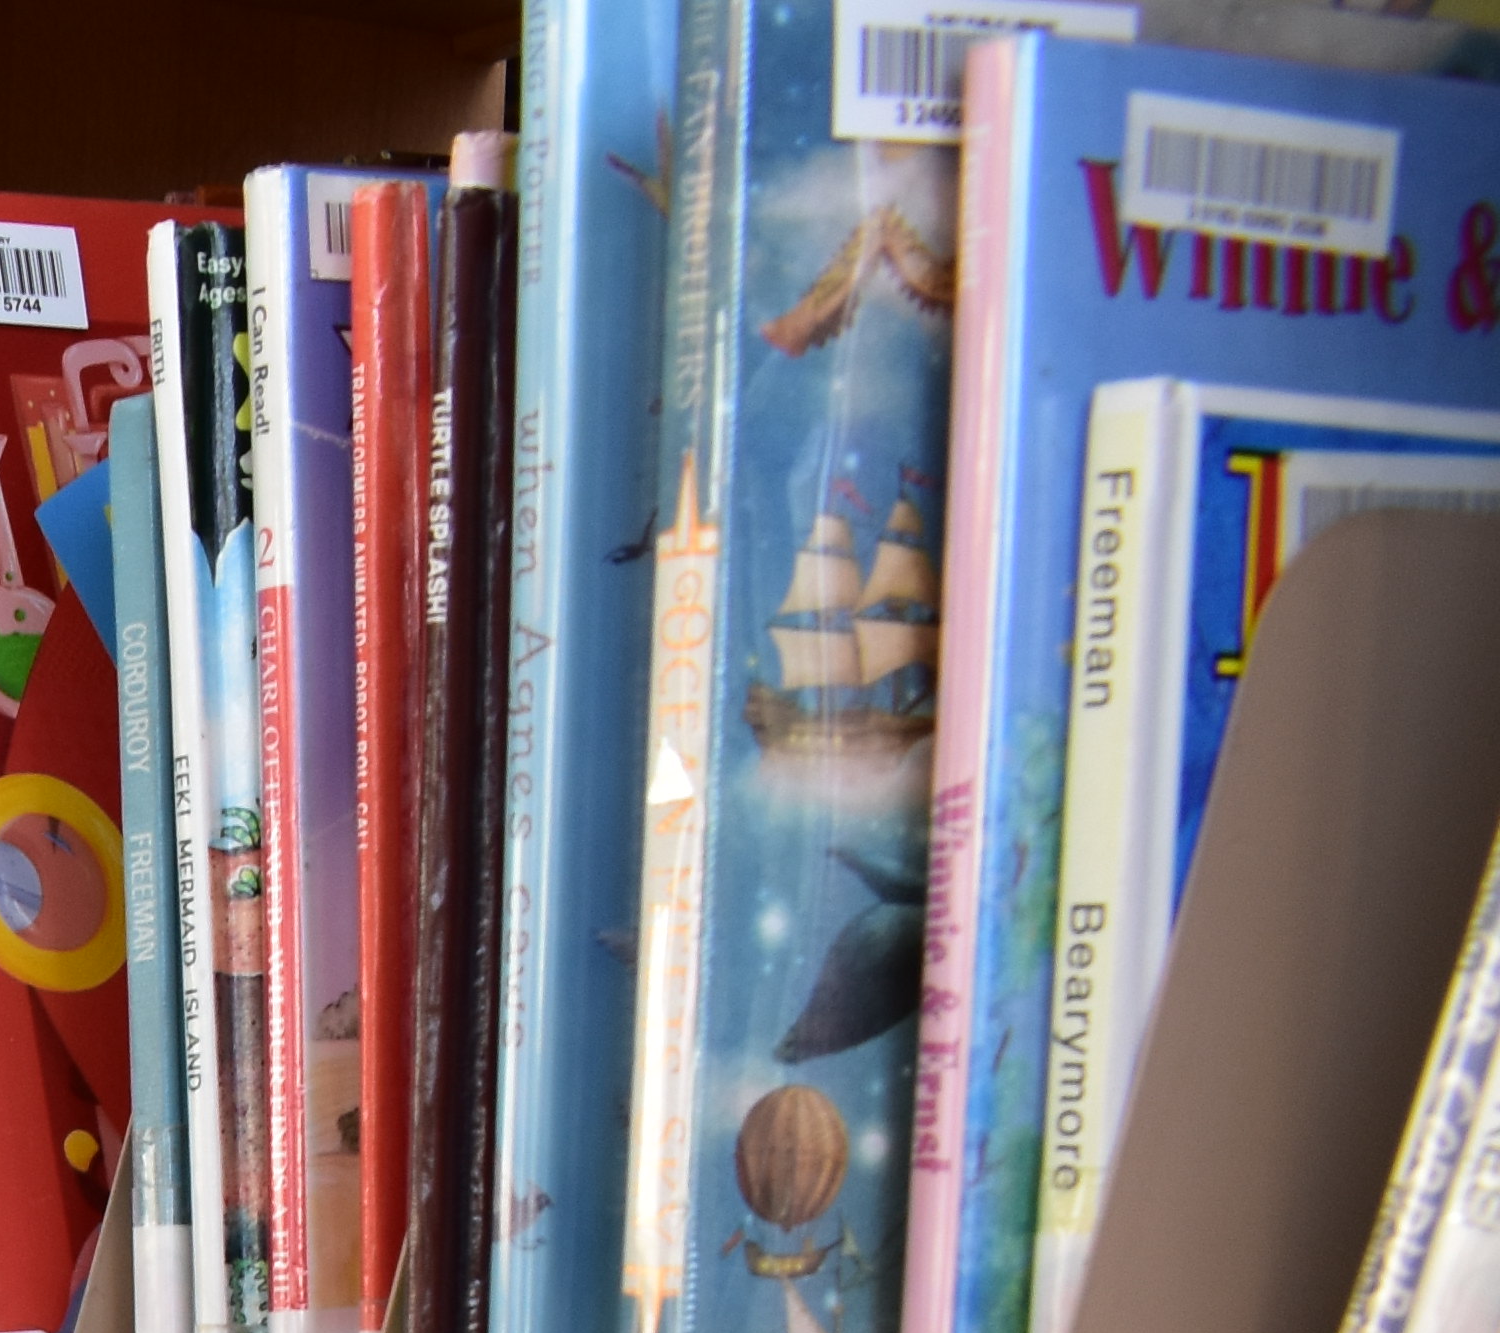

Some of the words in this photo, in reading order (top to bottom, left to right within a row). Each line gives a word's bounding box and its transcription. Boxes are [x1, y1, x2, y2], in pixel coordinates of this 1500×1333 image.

[2, 297, 41, 313] 5744
[250, 304, 268, 355] Can
[251, 286, 265, 295] I
[253, 362, 270, 437] Read!
[430, 386, 453, 494] TURTLE
[514, 409, 555, 579] when
[425, 502, 449, 623] SPLASH!
[1078, 466, 1135, 711] Freeman
[119, 621, 154, 773] CORDUROY
[505, 619, 554, 841] Agnes
[129, 830, 155, 963] FREEMAN
[177, 840, 197, 967] MERMAID
[925, 777, 972, 965] Winnie
[183, 988, 202, 1093] ISLAND
[922, 985, 960, 1020] &
[1040, 899, 1107, 1192] Bearymore
[913, 1041, 958, 1171] Ernst
